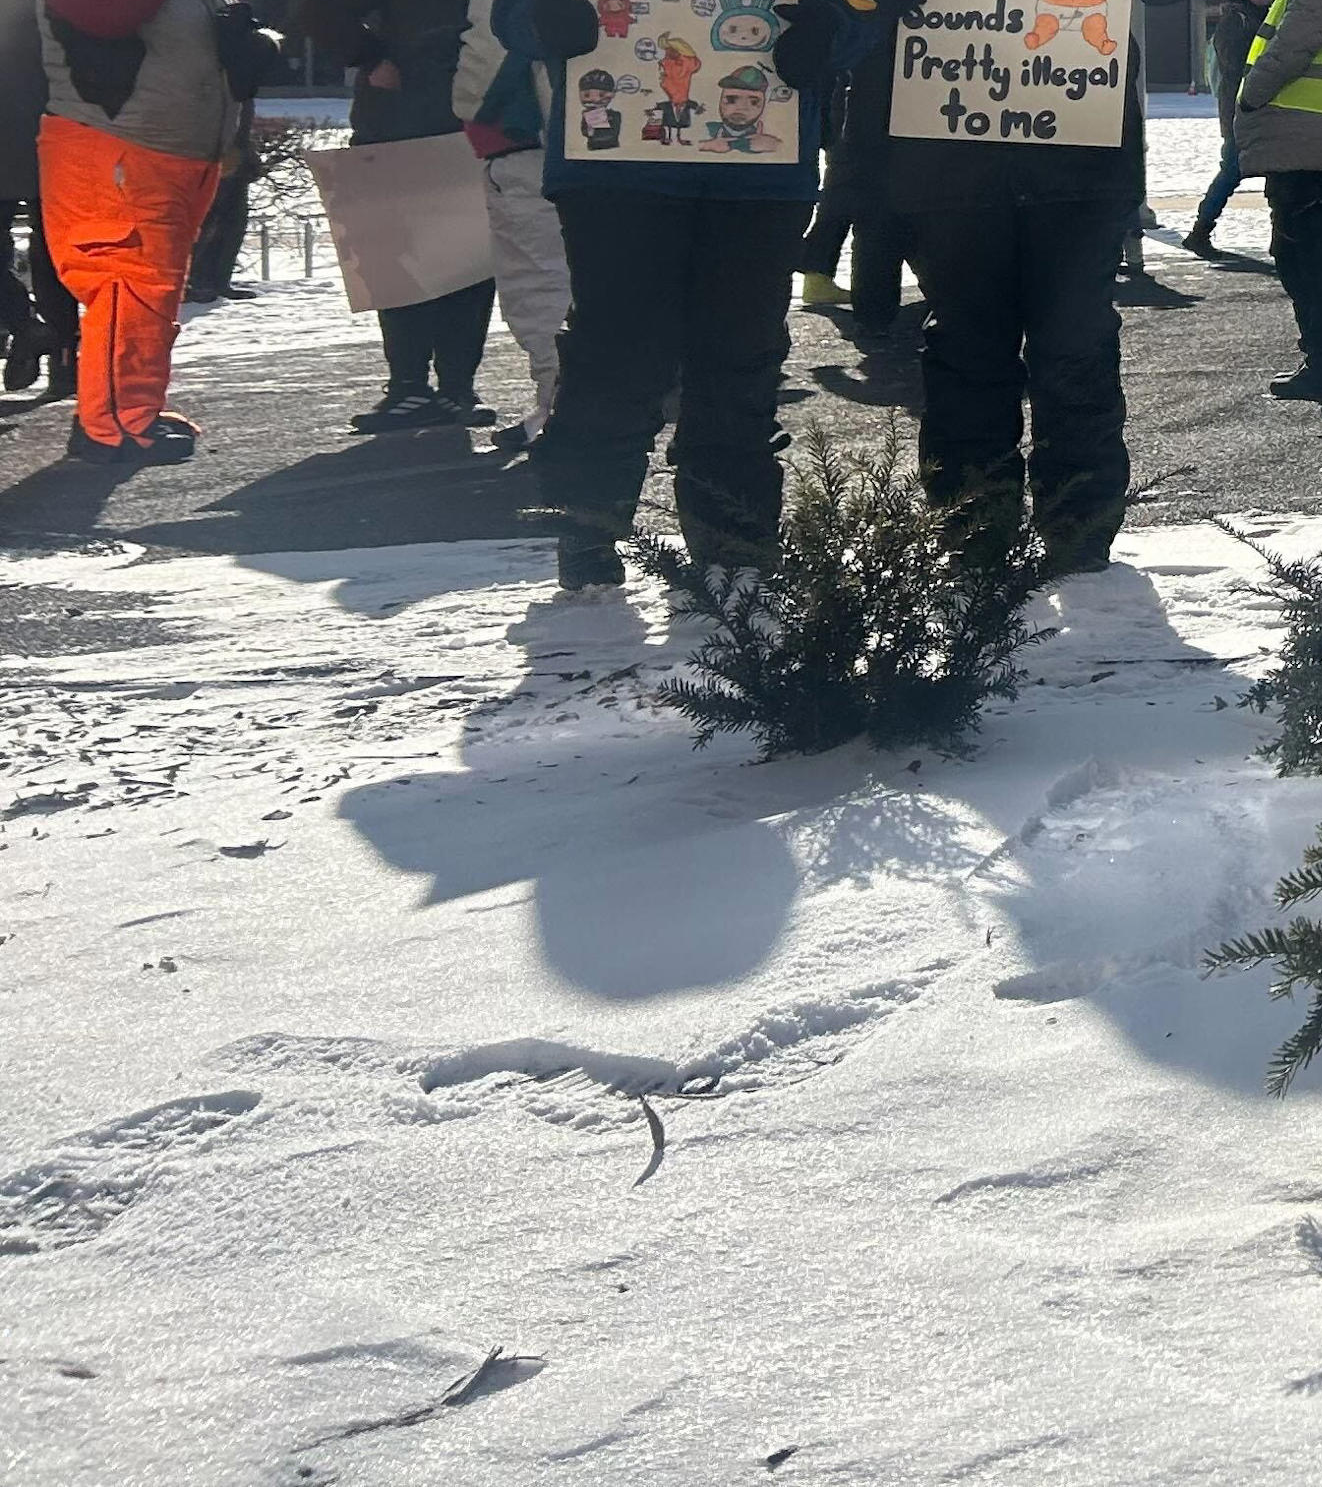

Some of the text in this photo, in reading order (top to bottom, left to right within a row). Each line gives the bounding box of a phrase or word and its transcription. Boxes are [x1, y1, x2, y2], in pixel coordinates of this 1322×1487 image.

[903, 36, 1119, 101] Pretty illegal
[940, 88, 1057, 139] to me
